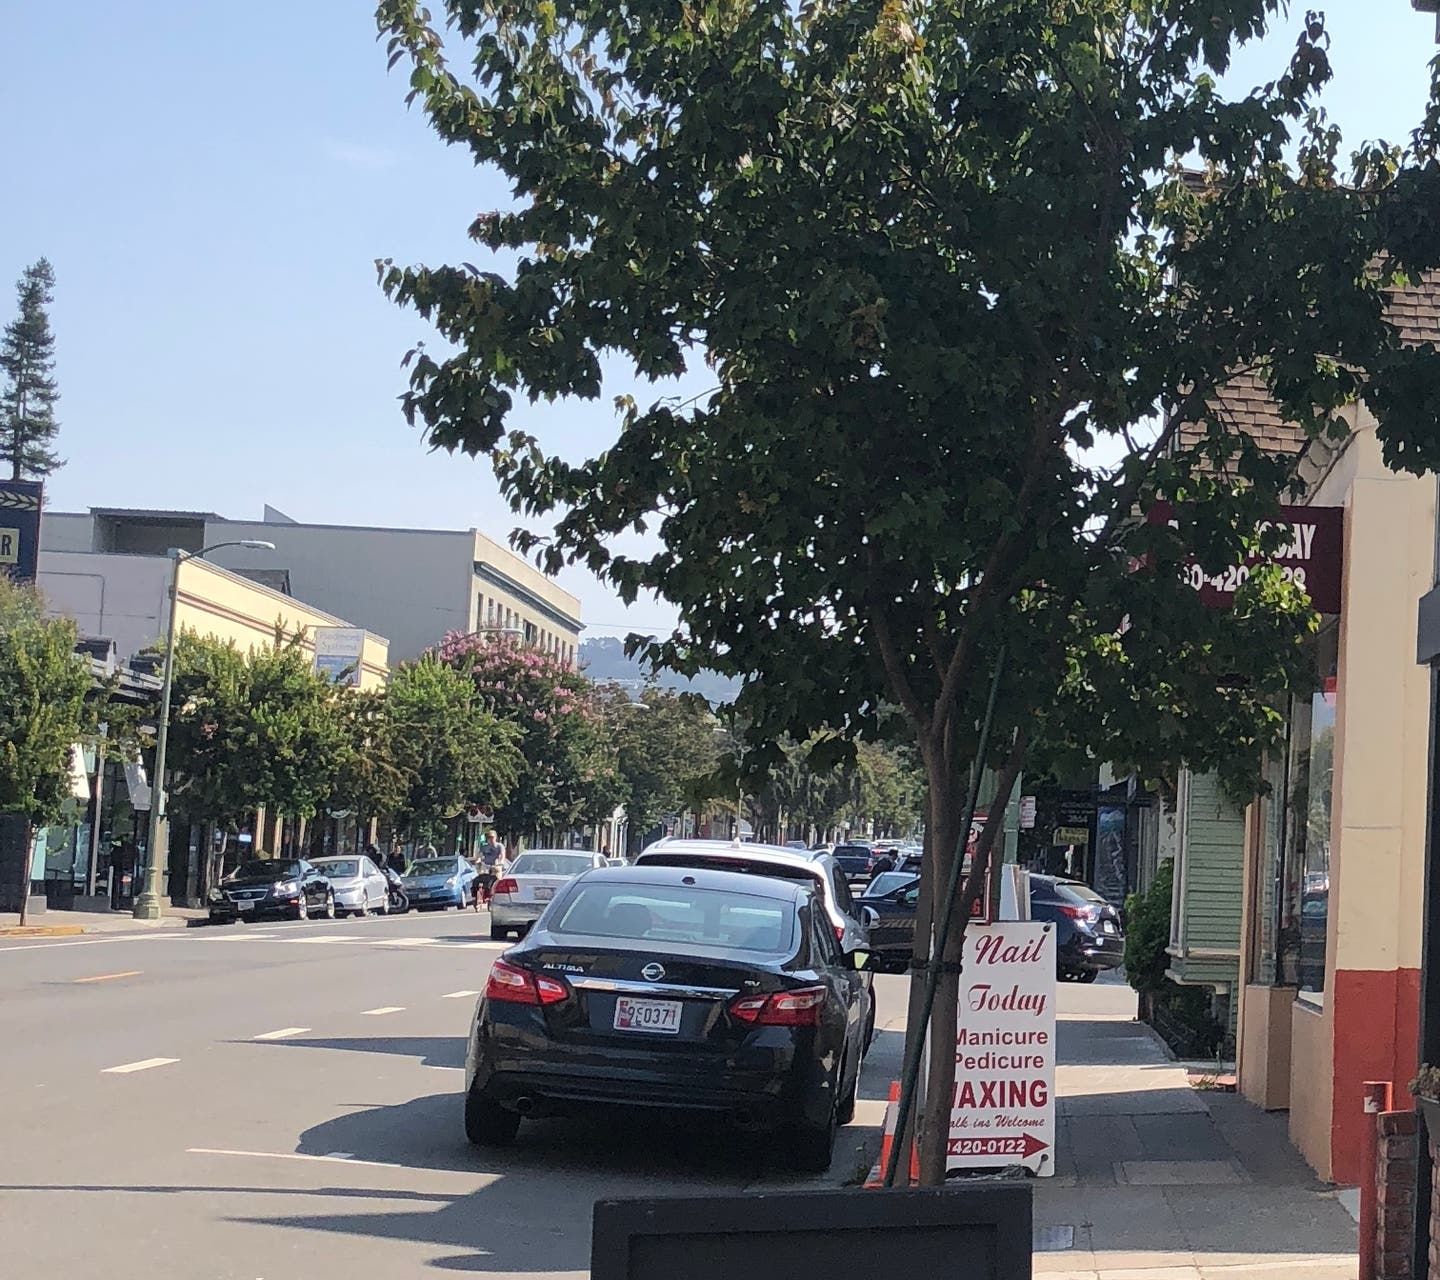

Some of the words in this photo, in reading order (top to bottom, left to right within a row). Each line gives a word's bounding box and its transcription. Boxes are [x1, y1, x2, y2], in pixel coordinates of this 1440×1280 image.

[974, 933, 1048, 965] Nail
[542, 963, 585, 973] ALTIMA
[967, 983, 1048, 1017] Today
[993, 1114, 1046, 1128] Welcome
